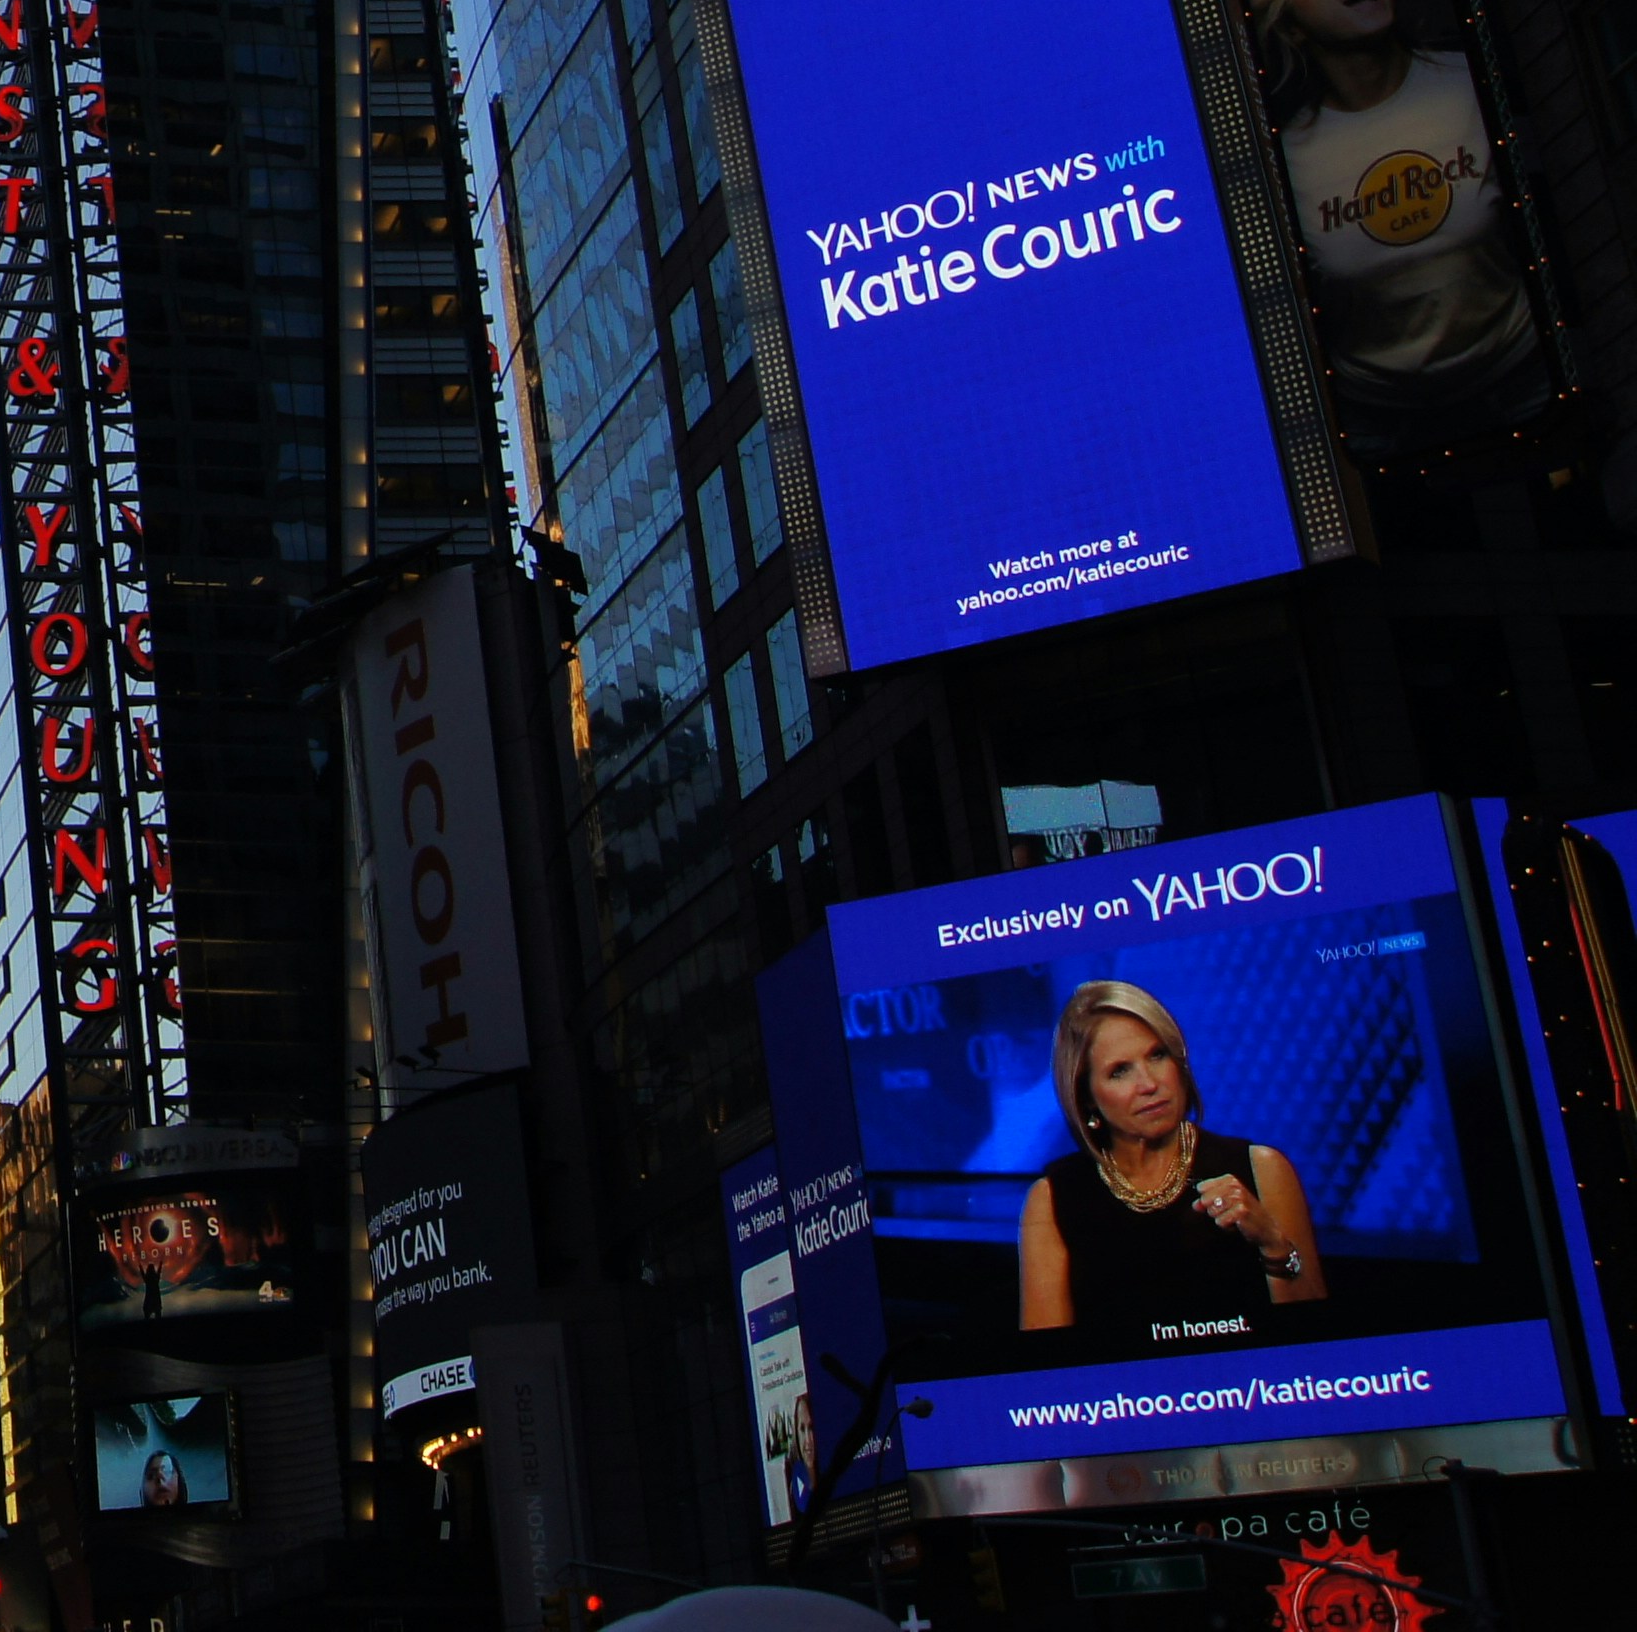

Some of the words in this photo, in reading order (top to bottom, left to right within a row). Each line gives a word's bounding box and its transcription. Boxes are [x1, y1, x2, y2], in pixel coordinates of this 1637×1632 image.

[807, 182, 975, 266] YAHOO!
[987, 153, 1097, 209] NEWS
[1104, 135, 1165, 174] with
[1318, 174, 1399, 232] Hard
[1399, 146, 1482, 201] Rock
[1389, 206, 1430, 232] CAFE
[820, 244, 976, 330] Katie
[982, 184, 1182, 280] Couric
[7, 337, 57, 396] &
[956, 544, 1190, 616] yahoo.com/katiecouric
[988, 550, 1053, 581] Watch
[1058, 538, 1112, 564] more
[1117, 529, 1138, 550] at
[26, 505, 117, 1013] YOUNG
[385, 617, 470, 1049] RICOH
[938, 900, 1085, 948] Exclusively
[1094, 895, 1129, 920] on
[1132, 845, 1325, 922] YAHOO!
[1315, 939, 1378, 966] YAHOO!
[1385, 936, 1421, 953] NEWS
[417, 1186, 436, 1211] for
[436, 1181, 464, 1212] you
[731, 1183, 756, 1215] Watch
[756, 1173, 779, 1203] Katie
[789, 1172, 827, 1217] YAHOO!
[827, 1164, 853, 1196] NEWS
[400, 1217, 447, 1270] CAN
[736, 1219, 752, 1244] the
[751, 1207, 775, 1236] Yahoo
[794, 1214, 831, 1260] Katie
[407, 1279, 428, 1305] way
[427, 1273, 452, 1303] you
[451, 1259, 493, 1289] bank.
[1151, 1322, 1180, 1342] I'm
[1182, 1314, 1253, 1340] honest.
[420, 1362, 467, 1394] CHASE
[1009, 1366, 1432, 1428] www.yahoo.com/katiecouric
[515, 1382, 540, 1487] REUTERS
[1285, 1499, 1371, 1535] café
[1132, 1568, 1162, 1586] AV
